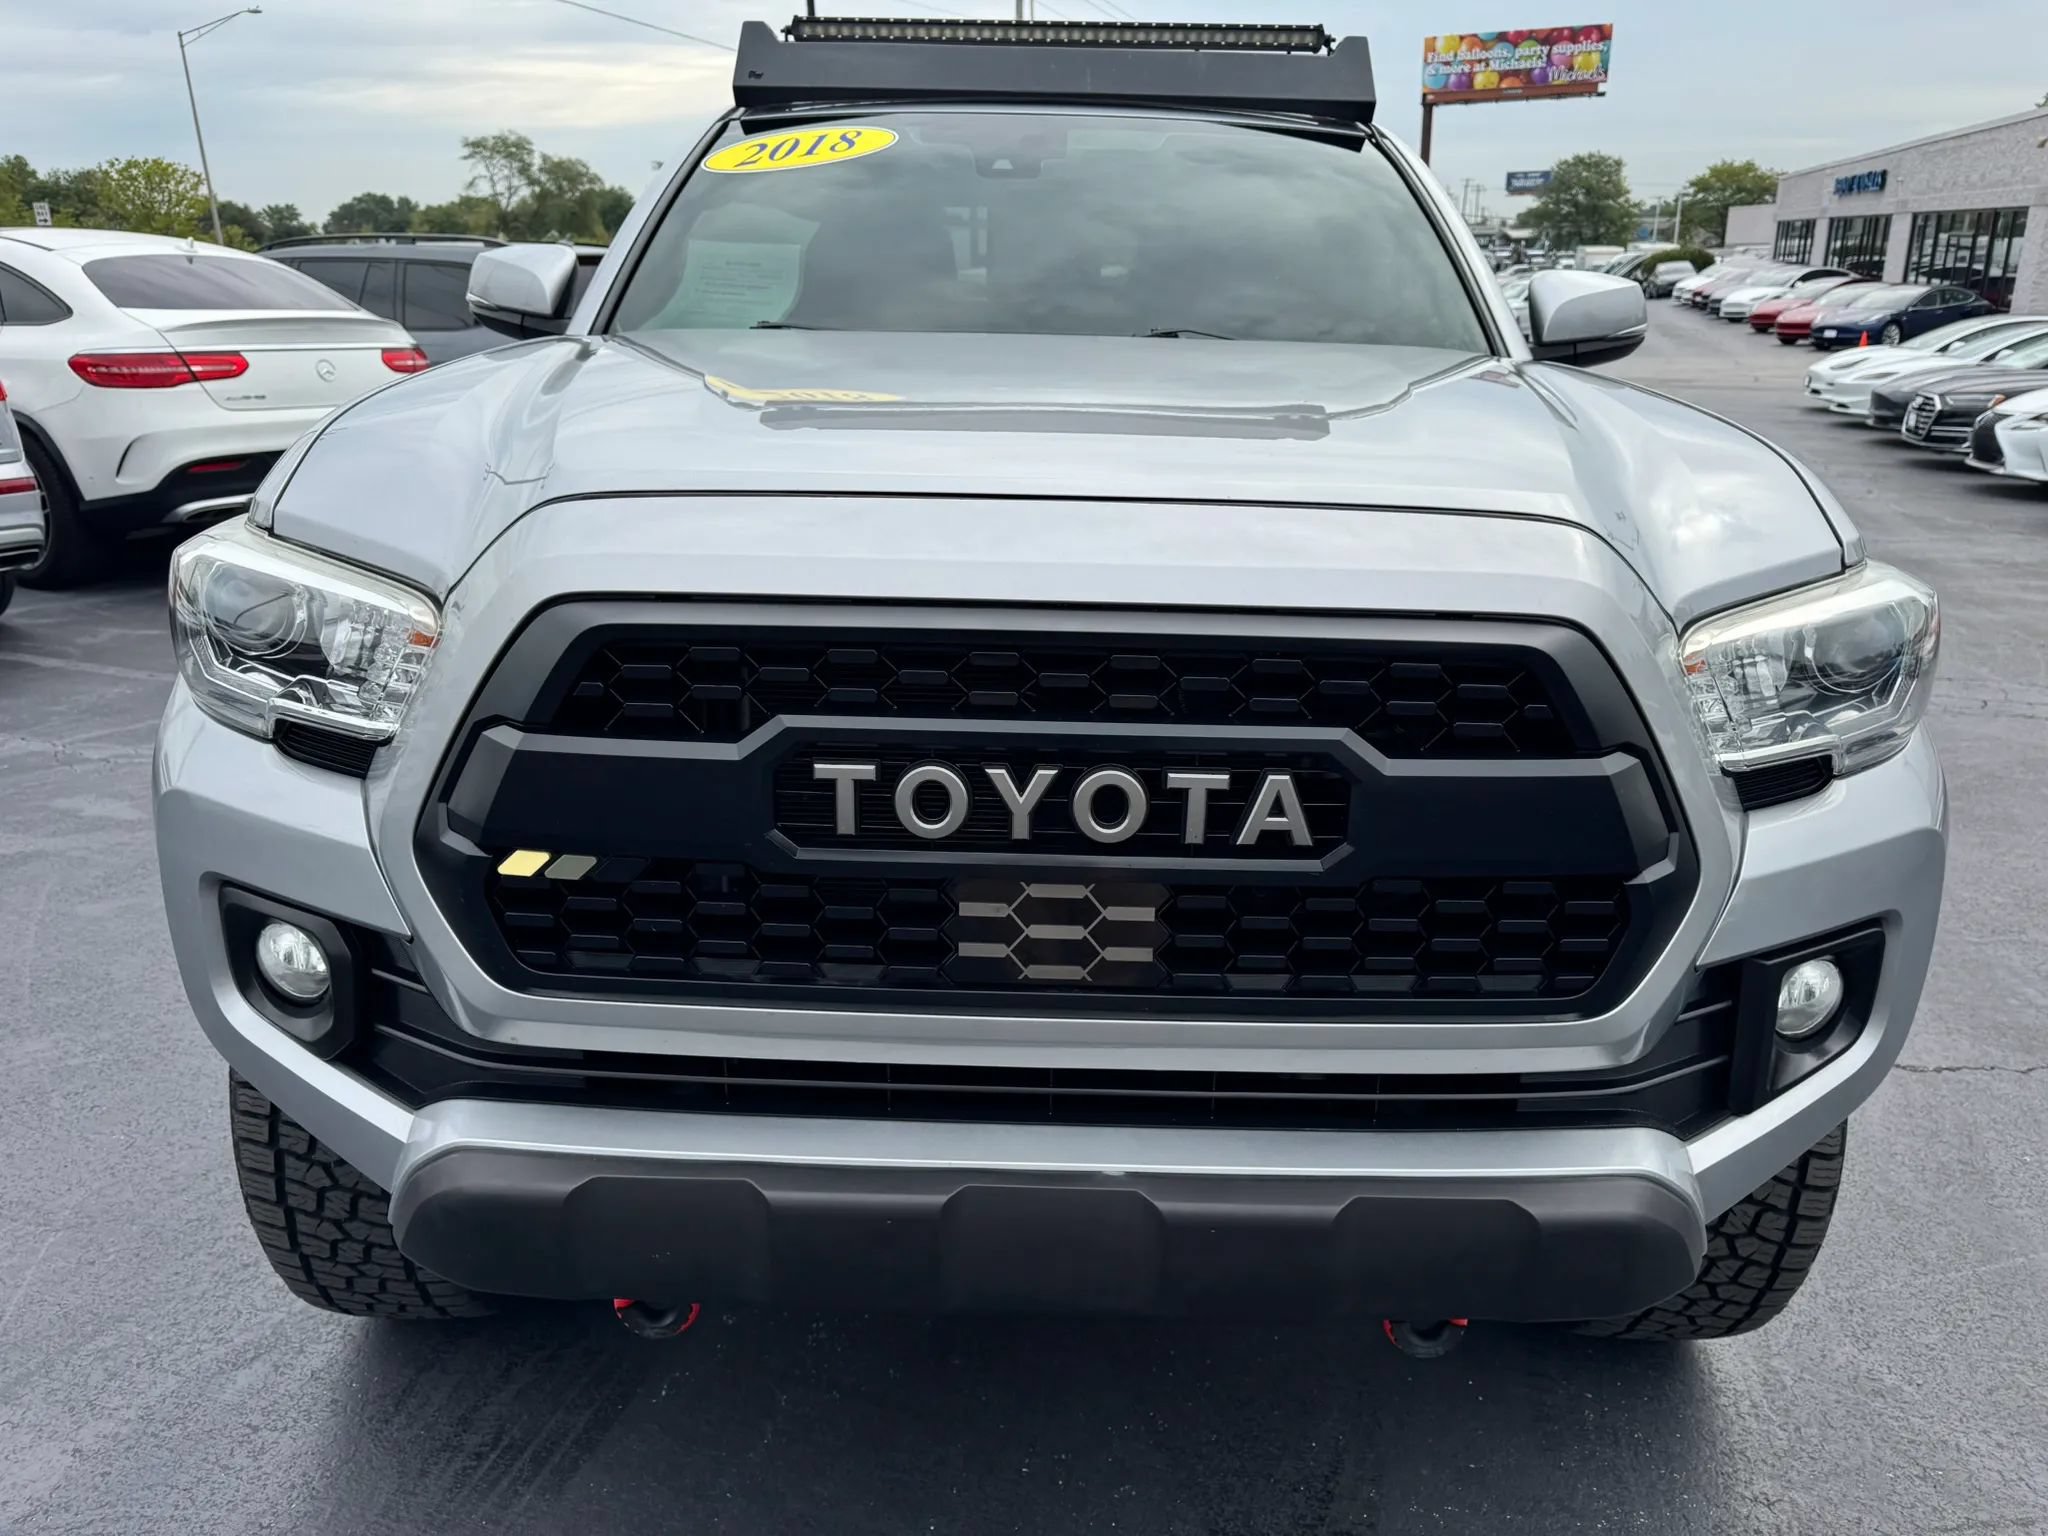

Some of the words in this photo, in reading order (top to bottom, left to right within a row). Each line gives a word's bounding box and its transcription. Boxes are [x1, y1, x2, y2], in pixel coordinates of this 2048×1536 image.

[1428, 51, 1454, 63] Find
[1515, 45, 1550, 59] party
[1439, 63, 1471, 74] more
[1473, 61, 1488, 72] at
[734, 130, 863, 168] 2018
[813, 763, 1314, 846] TOYOTA
